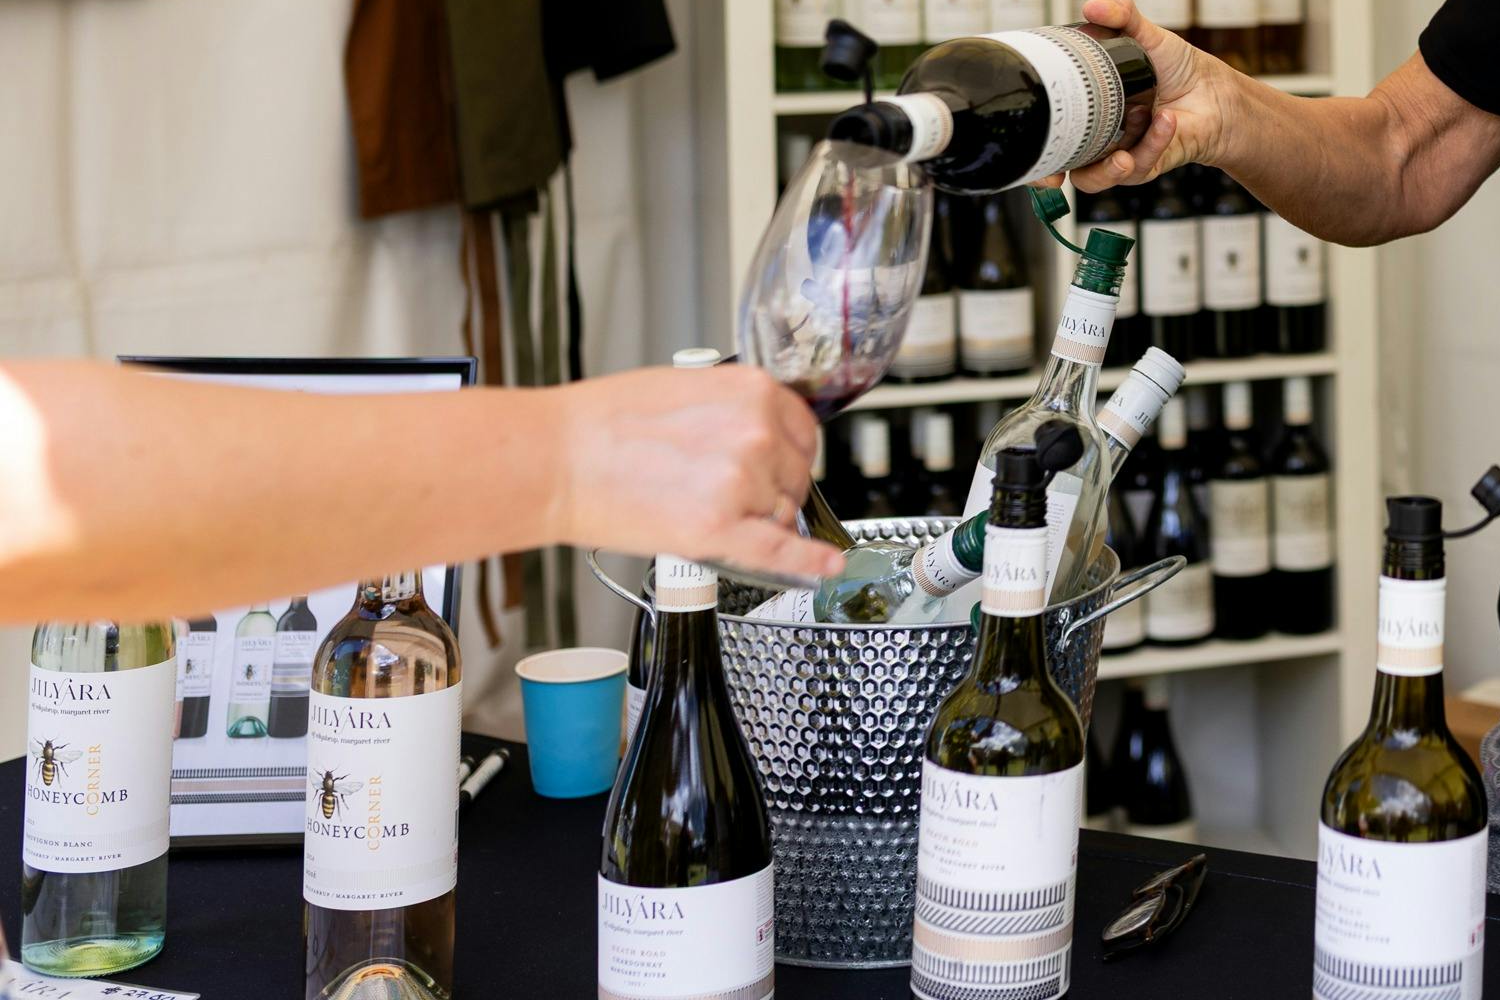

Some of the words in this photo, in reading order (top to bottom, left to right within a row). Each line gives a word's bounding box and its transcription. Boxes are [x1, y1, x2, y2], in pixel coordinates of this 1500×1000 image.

[1061, 315, 1106, 339] ILYARA
[60, 707, 92, 717] margaret
[93, 707, 111, 716] river
[340, 736, 372, 746] margaret
[373, 736, 391, 745] river
[86, 742, 102, 816] CORNER
[27, 783, 129, 806] HONEYCOMB
[367, 774, 382, 851] CORNER
[306, 815, 411, 840] HONEYCOMB
[63, 840, 93, 849] BLANC
[55, 855, 96, 863] MARGARET
[98, 852, 123, 862] RIVER
[335, 892, 377, 901] MARGARET
[379, 890, 405, 900] RIVER
